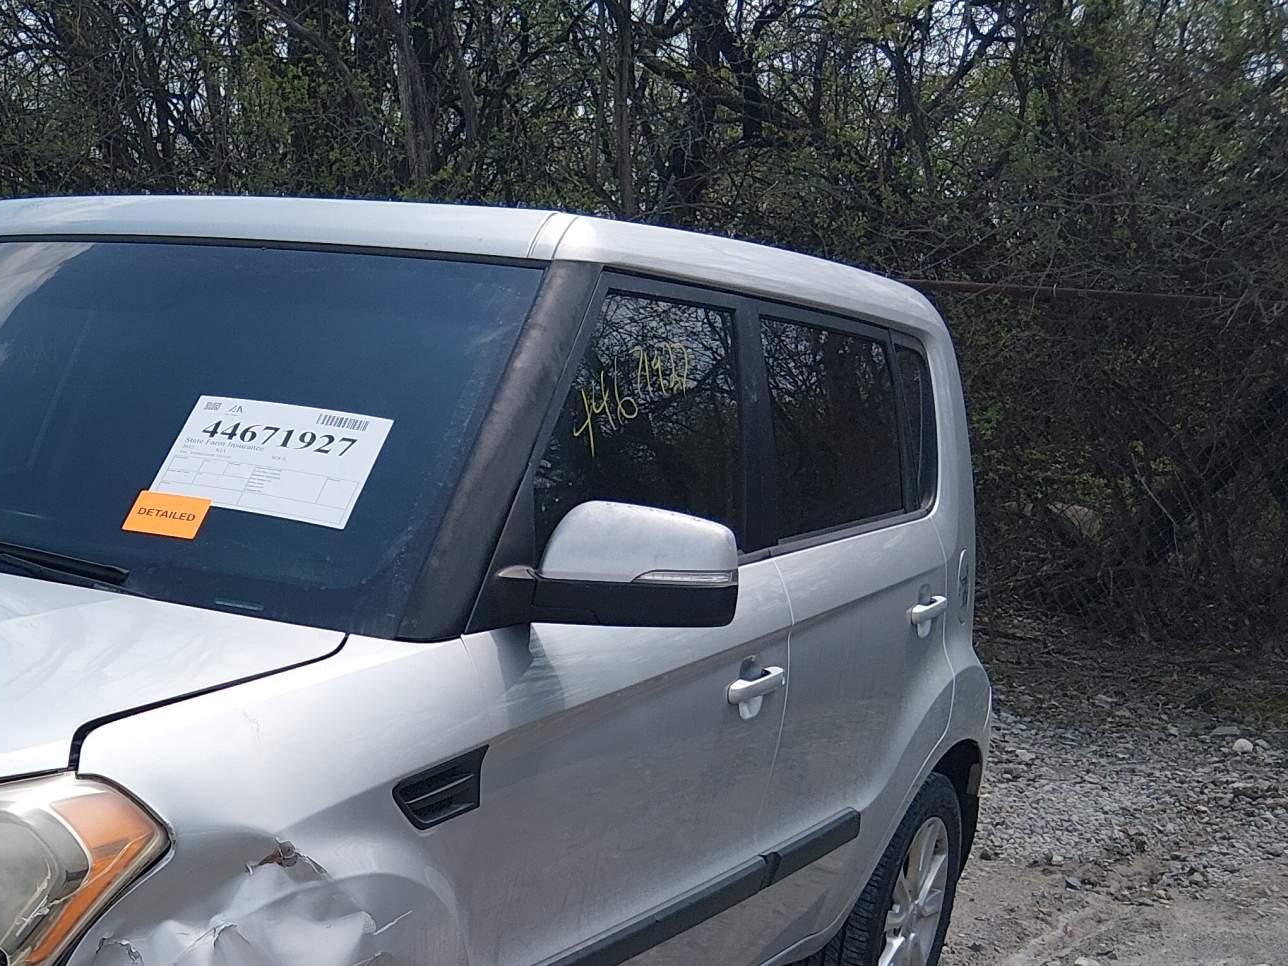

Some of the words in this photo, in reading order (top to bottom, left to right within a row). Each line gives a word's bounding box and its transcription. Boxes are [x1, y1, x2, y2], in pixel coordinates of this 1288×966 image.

[184, 437, 203, 446] State
[205, 439, 226, 448] Farm
[202, 420, 359, 457] 44671927
[137, 507, 196, 522] DETAILED
